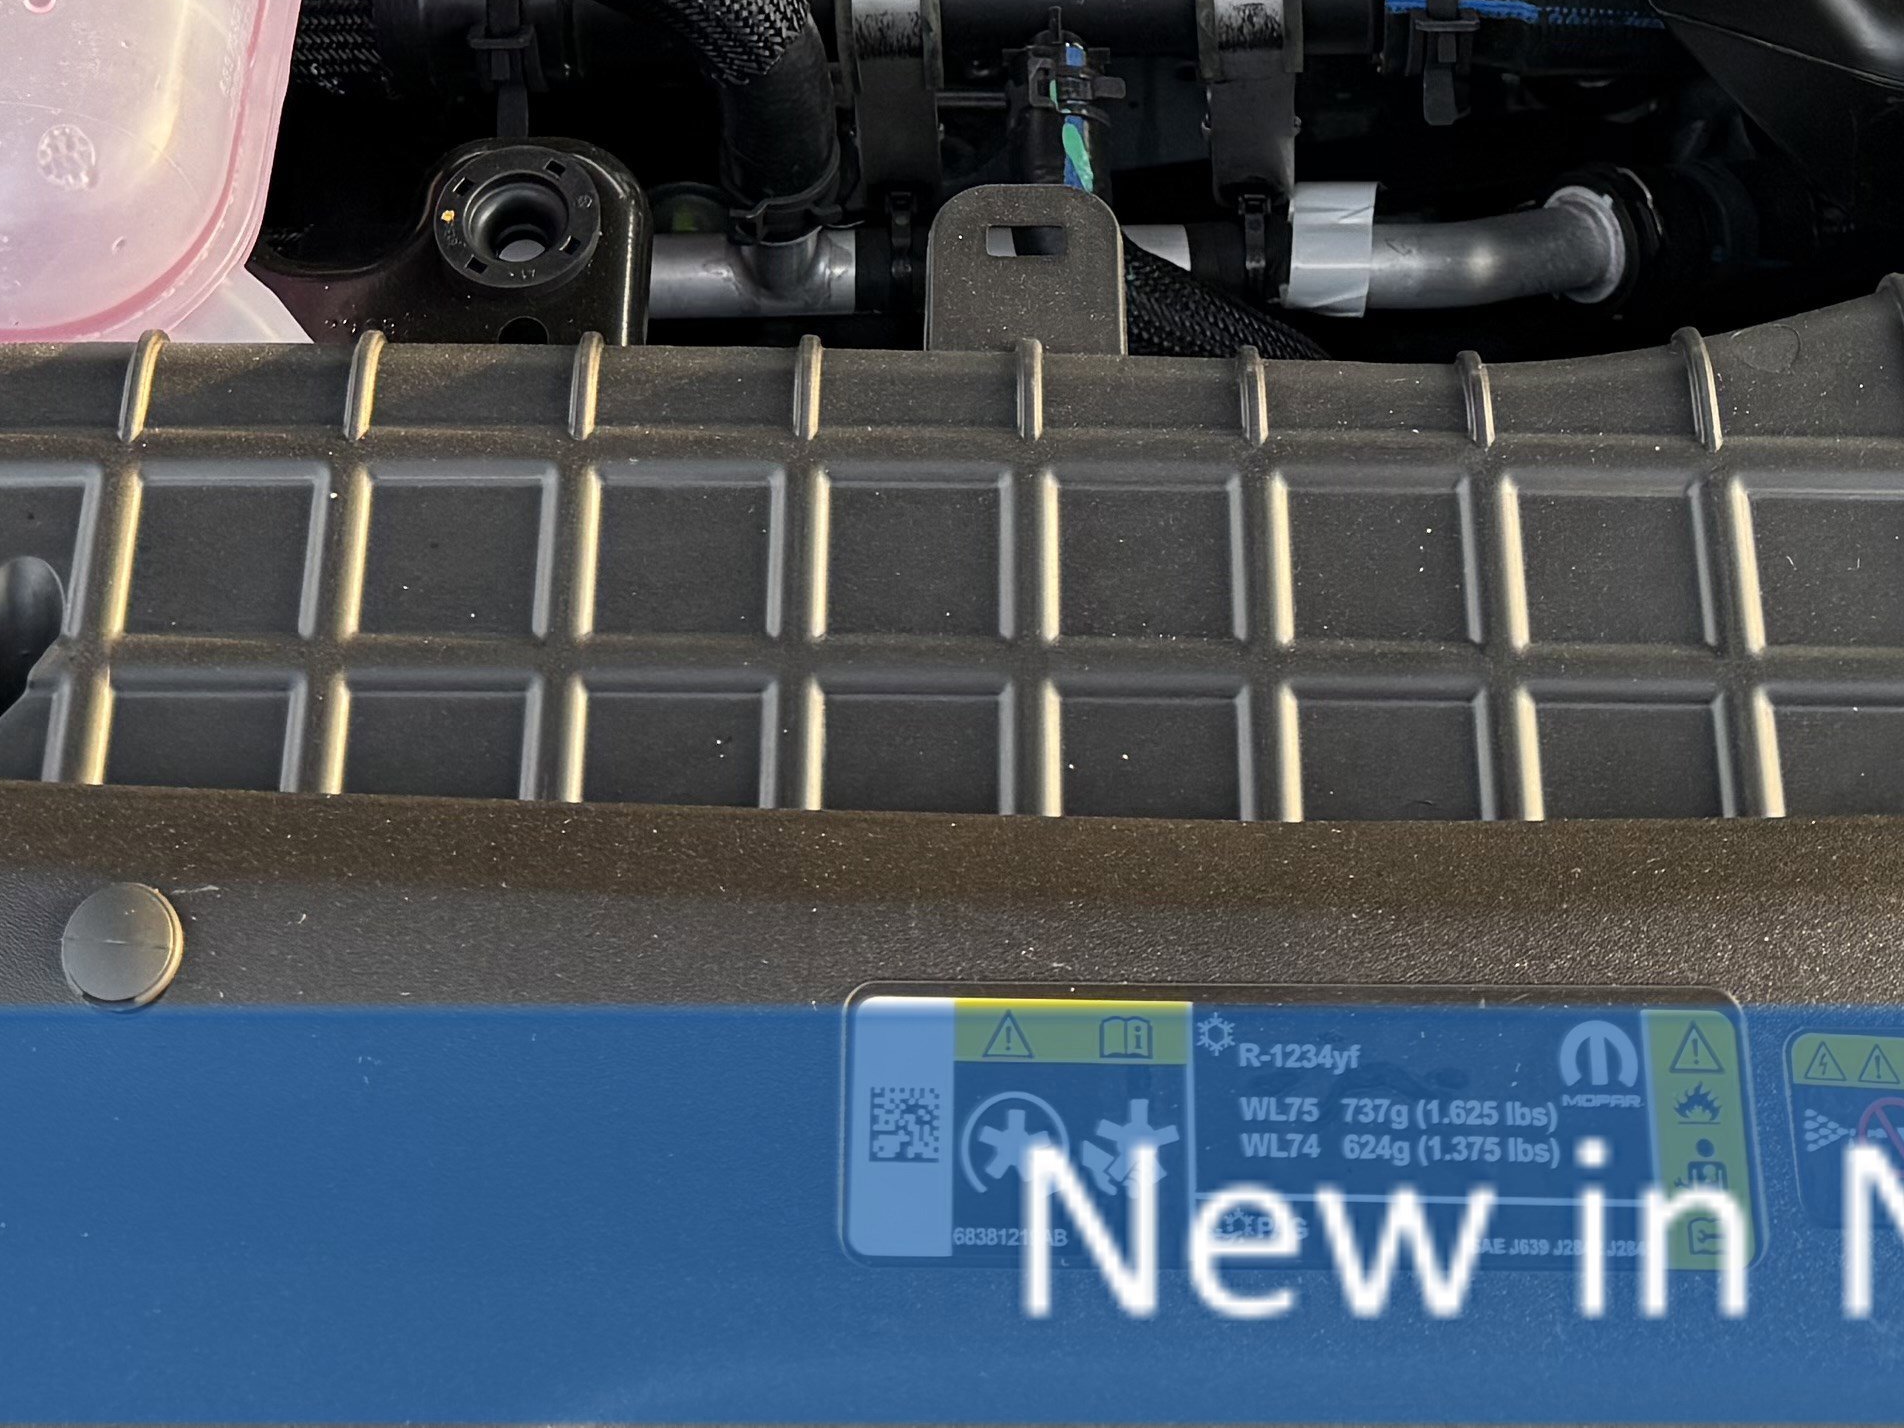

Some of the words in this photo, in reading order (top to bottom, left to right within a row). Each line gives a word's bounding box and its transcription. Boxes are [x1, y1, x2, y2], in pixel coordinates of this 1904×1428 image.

[1238, 1043, 1362, 1076] R-1234yf
[1239, 1096, 1321, 1123] WL75
[1341, 1097, 1409, 1130] 737g
[1416, 1099, 1500, 1131] (1.625
[1506, 1101, 1559, 1134] lbs)
[1561, 1093, 1645, 1109] MOPAR
[1241, 1132, 1322, 1159] WL74
[1343, 1133, 1412, 1167] 624g
[1417, 1134, 1502, 1168] (1.375
[1506, 1136, 1561, 1170] lbs)
